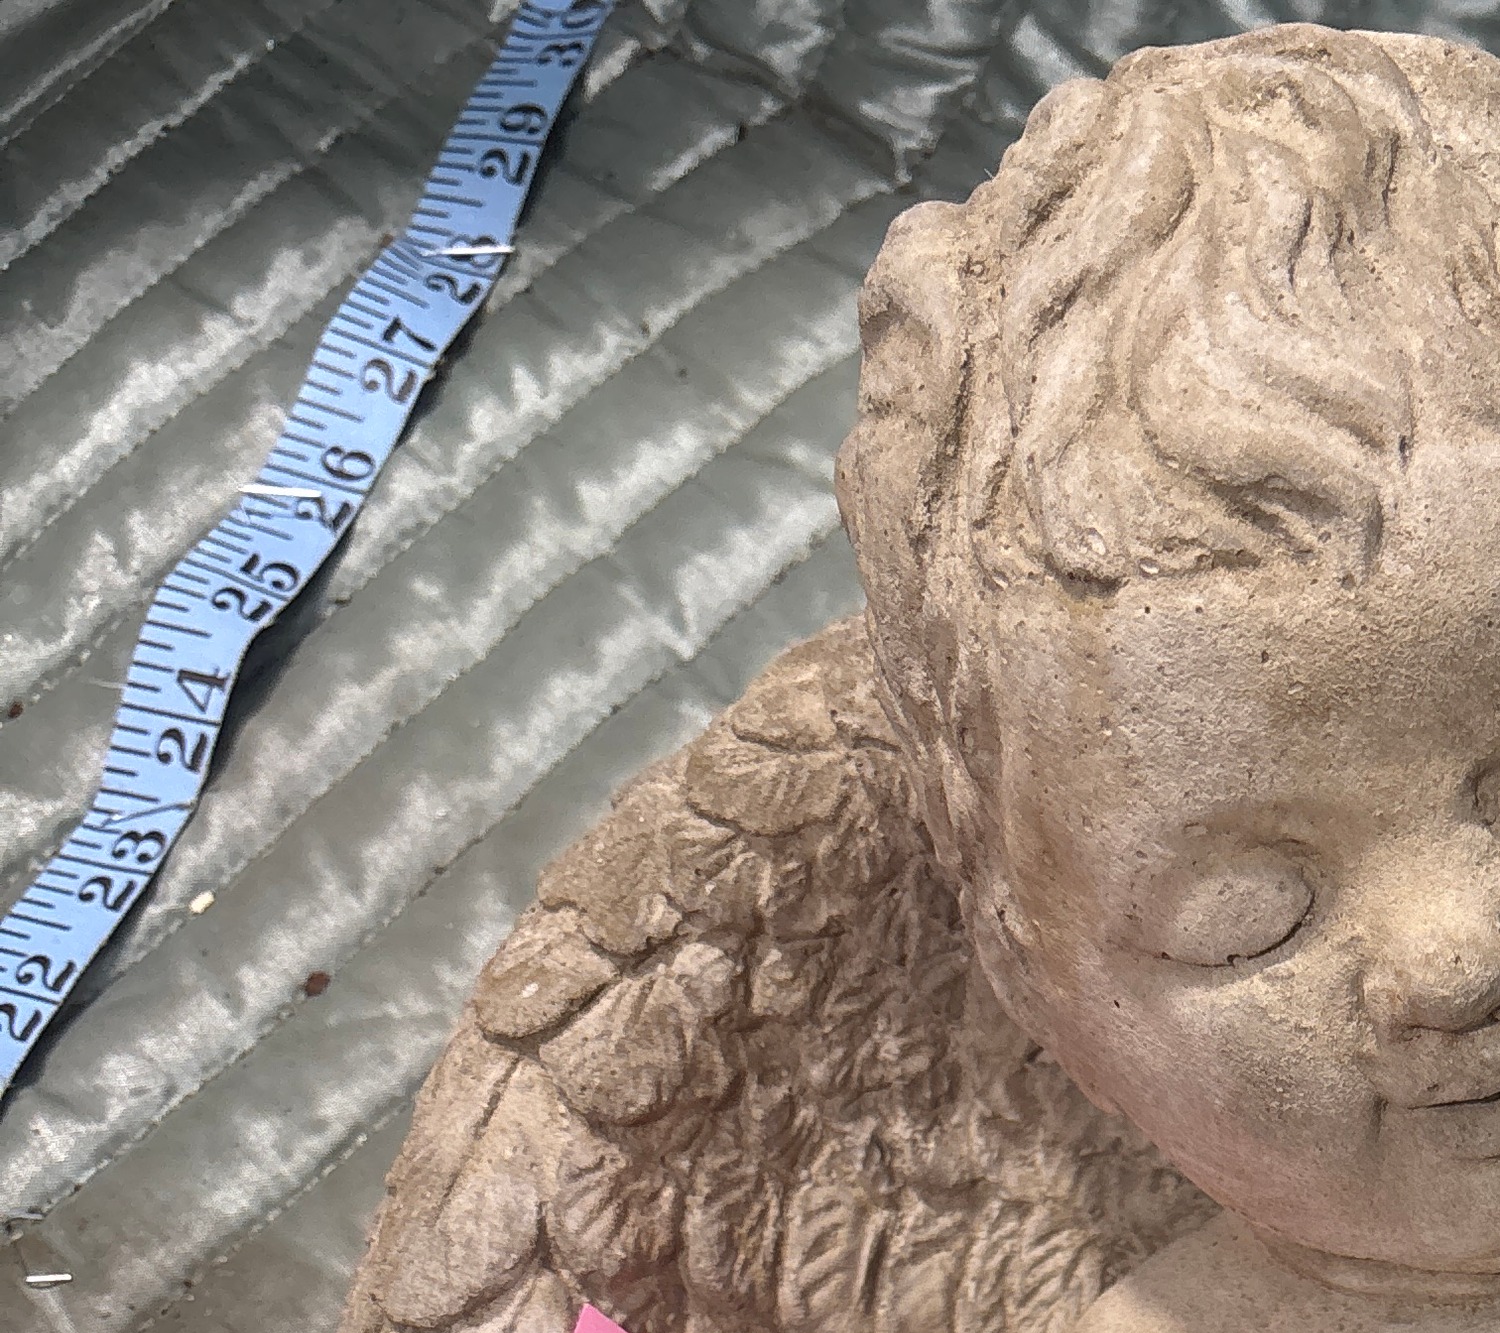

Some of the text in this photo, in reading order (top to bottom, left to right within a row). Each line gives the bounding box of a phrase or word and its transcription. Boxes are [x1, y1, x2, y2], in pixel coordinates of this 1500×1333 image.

[480, 102, 547, 186] 29
[426, 235, 498, 306] 28
[361, 319, 438, 403] 27
[296, 446, 376, 530] 26
[212, 552, 300, 622] 25
[157, 668, 230, 773] 24
[78, 829, 168, 913] 23
